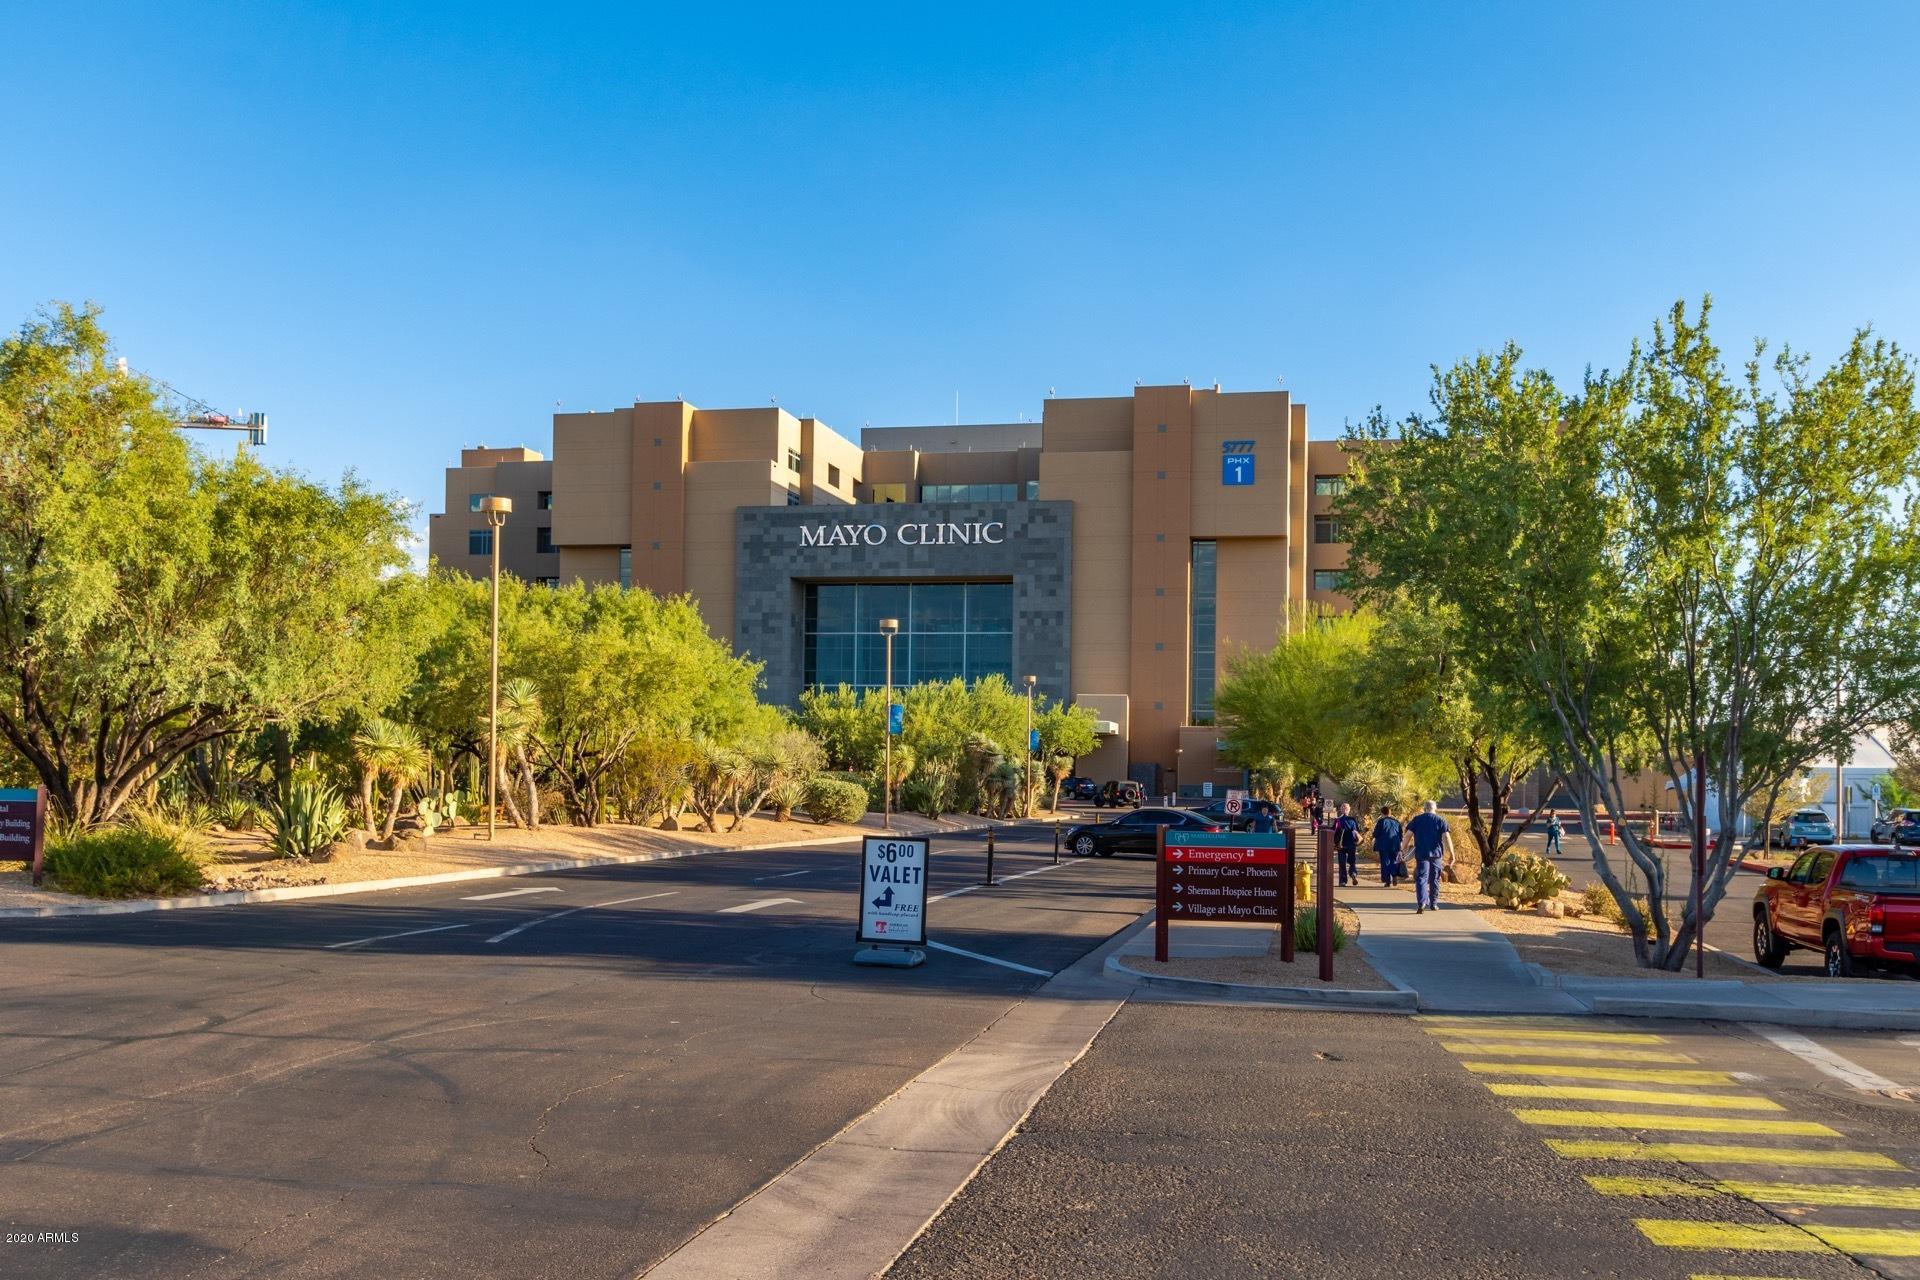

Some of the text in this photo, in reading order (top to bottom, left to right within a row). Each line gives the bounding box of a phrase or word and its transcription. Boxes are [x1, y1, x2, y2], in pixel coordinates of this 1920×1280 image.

[1234, 466, 1242, 483] 1
[800, 522, 1004, 546] MAYO CLINIC
[5, 819, 31, 829] Building
[1188, 849, 1244, 862] Emergency
[869, 864, 921, 884] VALET
[1188, 865, 1220, 878] Primary
[1221, 866, 1240, 876] Care
[1246, 867, 1278, 877] Phoenix
[1187, 885, 1277, 899] Sherman Hospice Home
[894, 903, 919, 912] FREE
[1187, 904, 1278, 918] Village at Mayo Clinic
